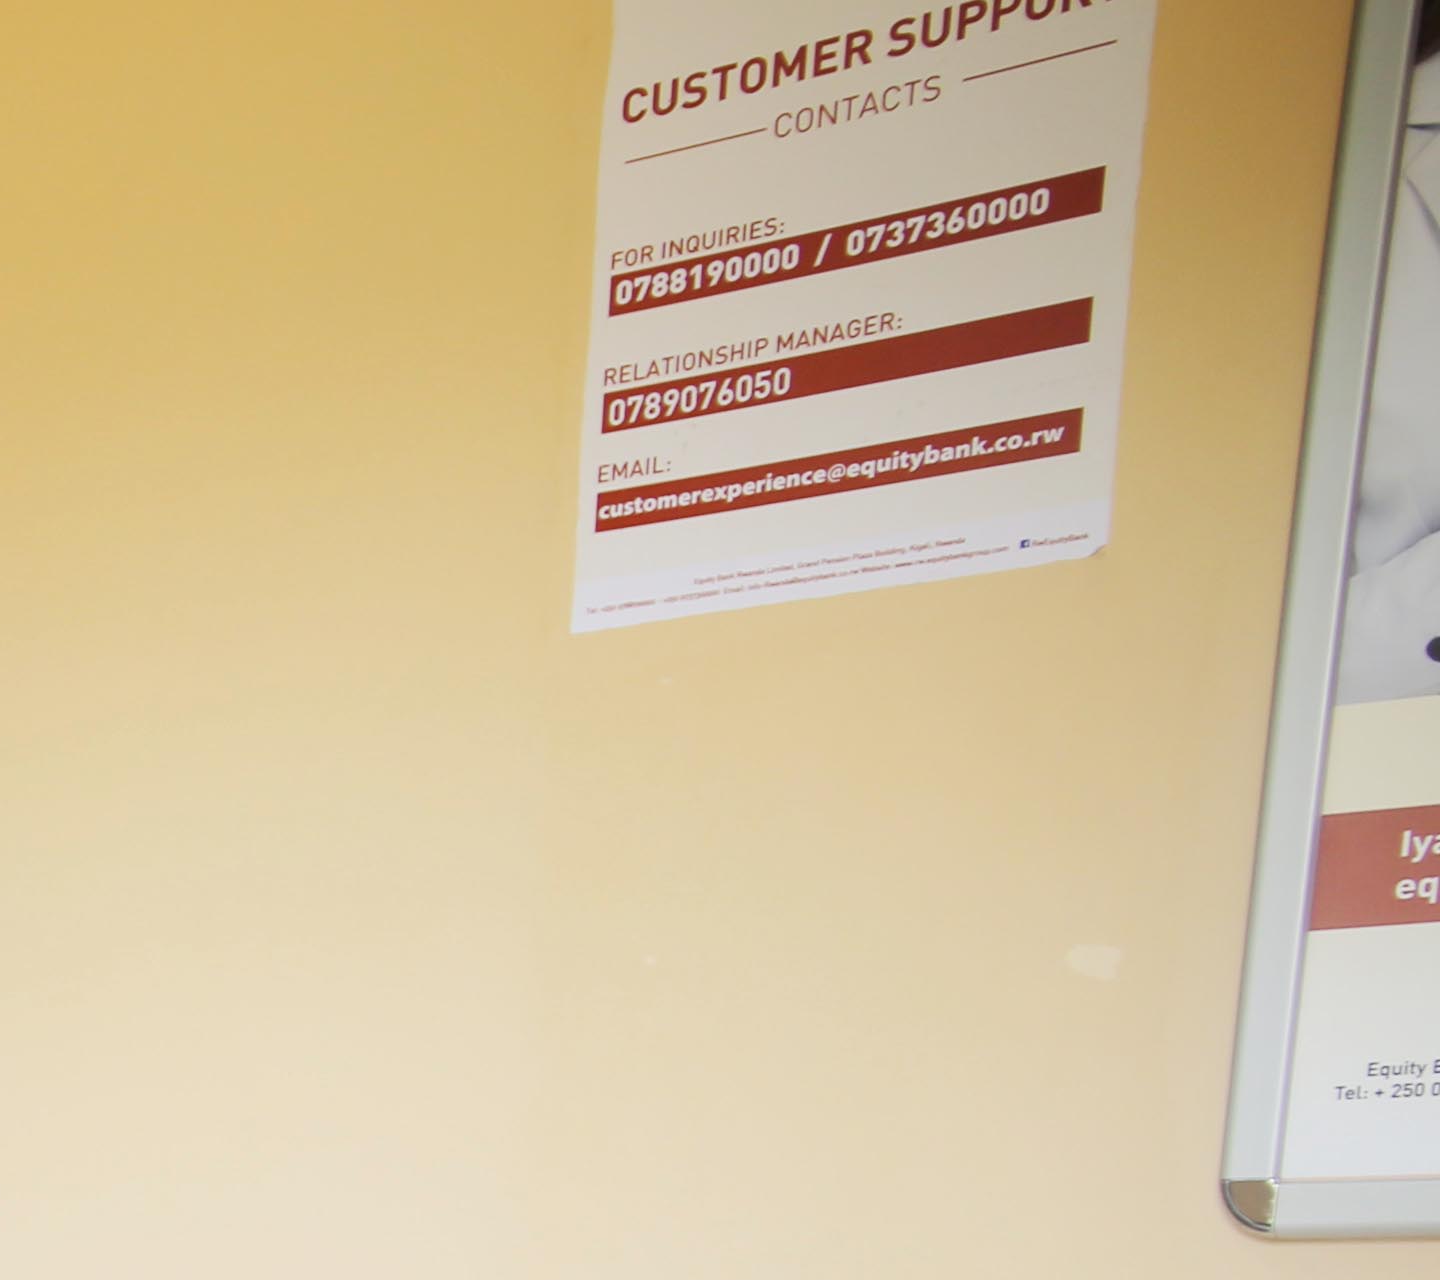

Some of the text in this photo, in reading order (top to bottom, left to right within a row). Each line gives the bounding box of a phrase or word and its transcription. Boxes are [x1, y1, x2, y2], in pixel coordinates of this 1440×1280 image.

[622, 0, 1112, 123] CUSTOMER SUPPO
[773, 75, 942, 139] CONTACTS
[610, 217, 785, 270] FOR INQUIRIES:
[615, 187, 1051, 306] 0788190000 / 0737360000
[603, 312, 903, 387] RELATIONSHIP MANAGER:
[608, 366, 792, 427] 0789076050
[597, 456, 671, 484] EMAIL:
[598, 423, 1065, 520] customerexperience@equitybank.co.rw
[1334, 1086, 1368, 1100] Tel:
[1391, 1082, 1425, 1098] 250
[1367, 1060, 1427, 1078] Equity
